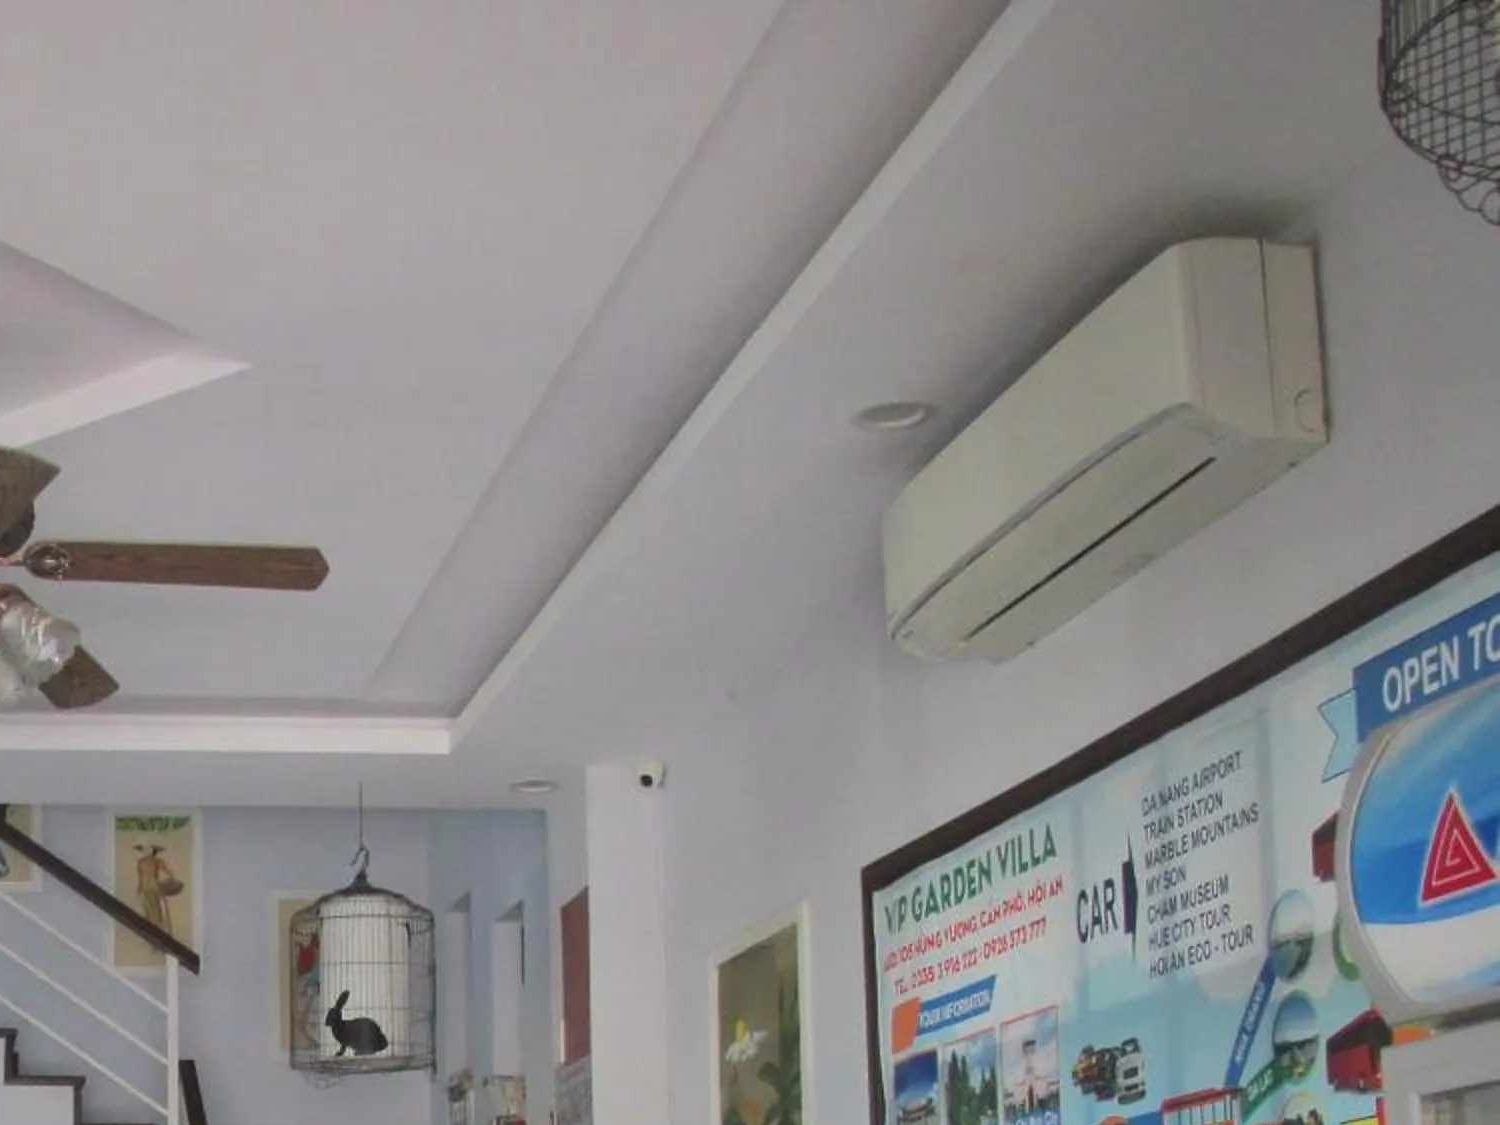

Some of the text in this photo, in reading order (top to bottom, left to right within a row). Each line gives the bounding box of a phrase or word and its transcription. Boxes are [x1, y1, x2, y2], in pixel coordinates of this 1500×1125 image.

[1382, 635, 1460, 713] OPEN
[1158, 777, 1190, 806] NANG
[1191, 750, 1242, 792] AIRPORT
[1143, 790, 1223, 844] TRAIN STATION
[1144, 802, 1259, 869] MARBLE MOUNTAINS
[911, 851, 992, 922] GARDEN
[997, 824, 1057, 878] VILLA
[1145, 865, 1187, 896] MY SON
[1147, 873, 1229, 925] CHAM MUSEUM
[1076, 877, 1118, 944] CAR
[1148, 903, 1231, 951] HUE CITY TOUR
[1187, 939, 1211, 966] ECO
[1221, 923, 1253, 952] TOUR
